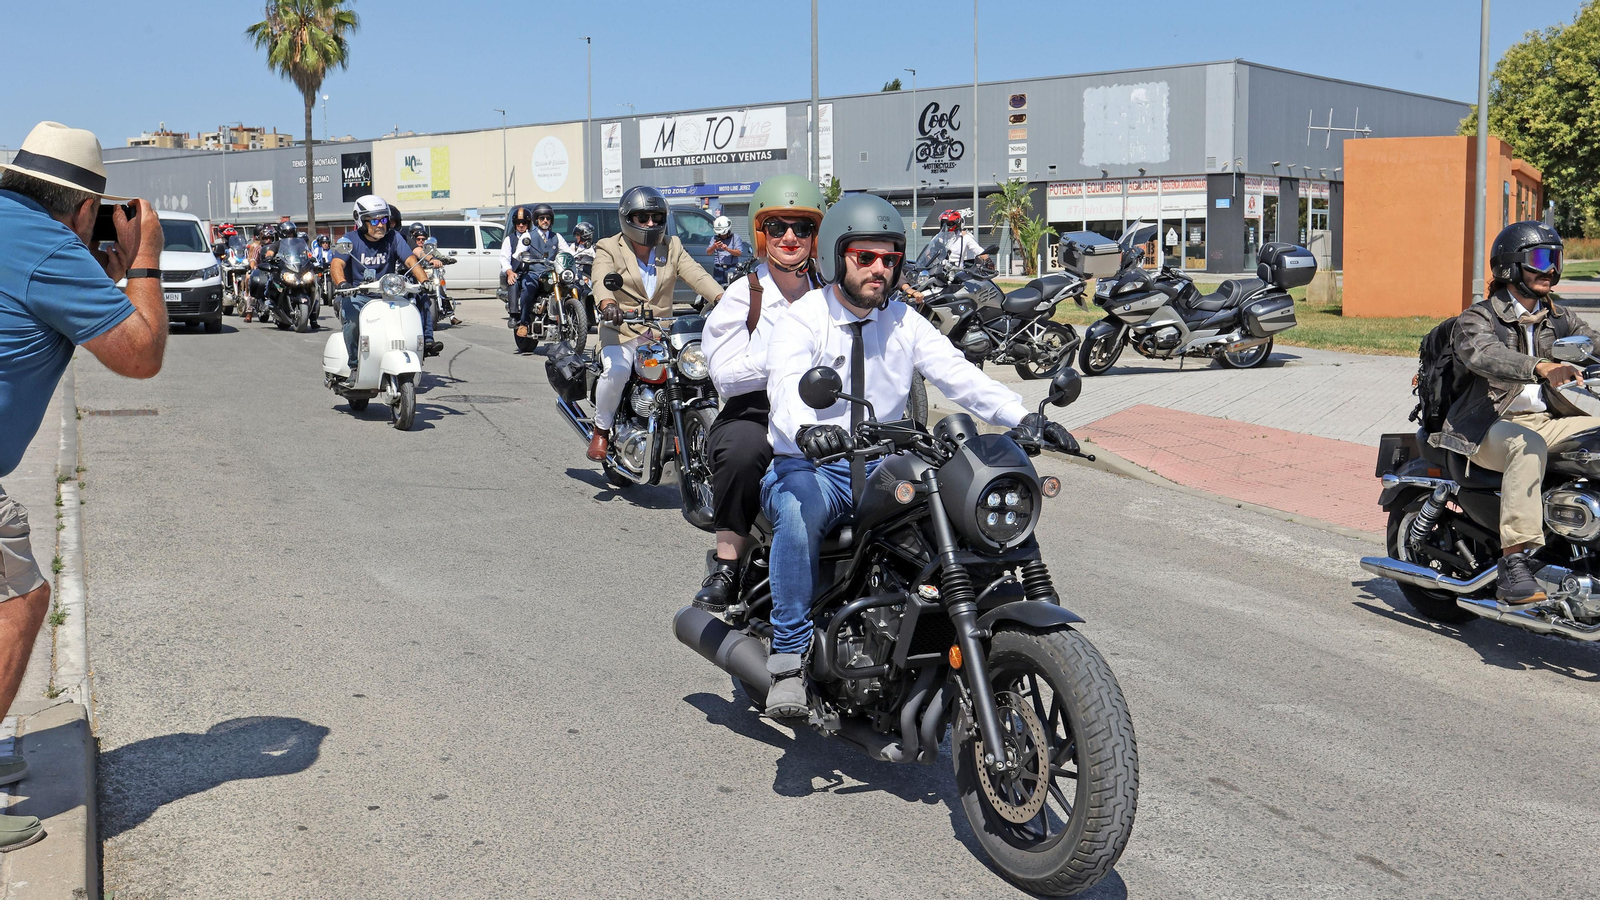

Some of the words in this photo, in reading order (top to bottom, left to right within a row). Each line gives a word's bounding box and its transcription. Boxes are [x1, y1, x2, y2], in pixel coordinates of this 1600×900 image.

[918, 102, 961, 136] Cool
[314, 156, 338, 166] MONTAÑA
[654, 158, 682, 167] TALLER
[684, 154, 728, 165] MECANICO
[731, 153, 737, 162] Y
[738, 150, 772, 161] VENTAS
[299, 175, 330, 184] RODROMO
[1128, 179, 1158, 191] AGILIDAD
[1049, 183, 1083, 195] POTENCIA
[1087, 181, 1122, 193] EQUILIBRIO
